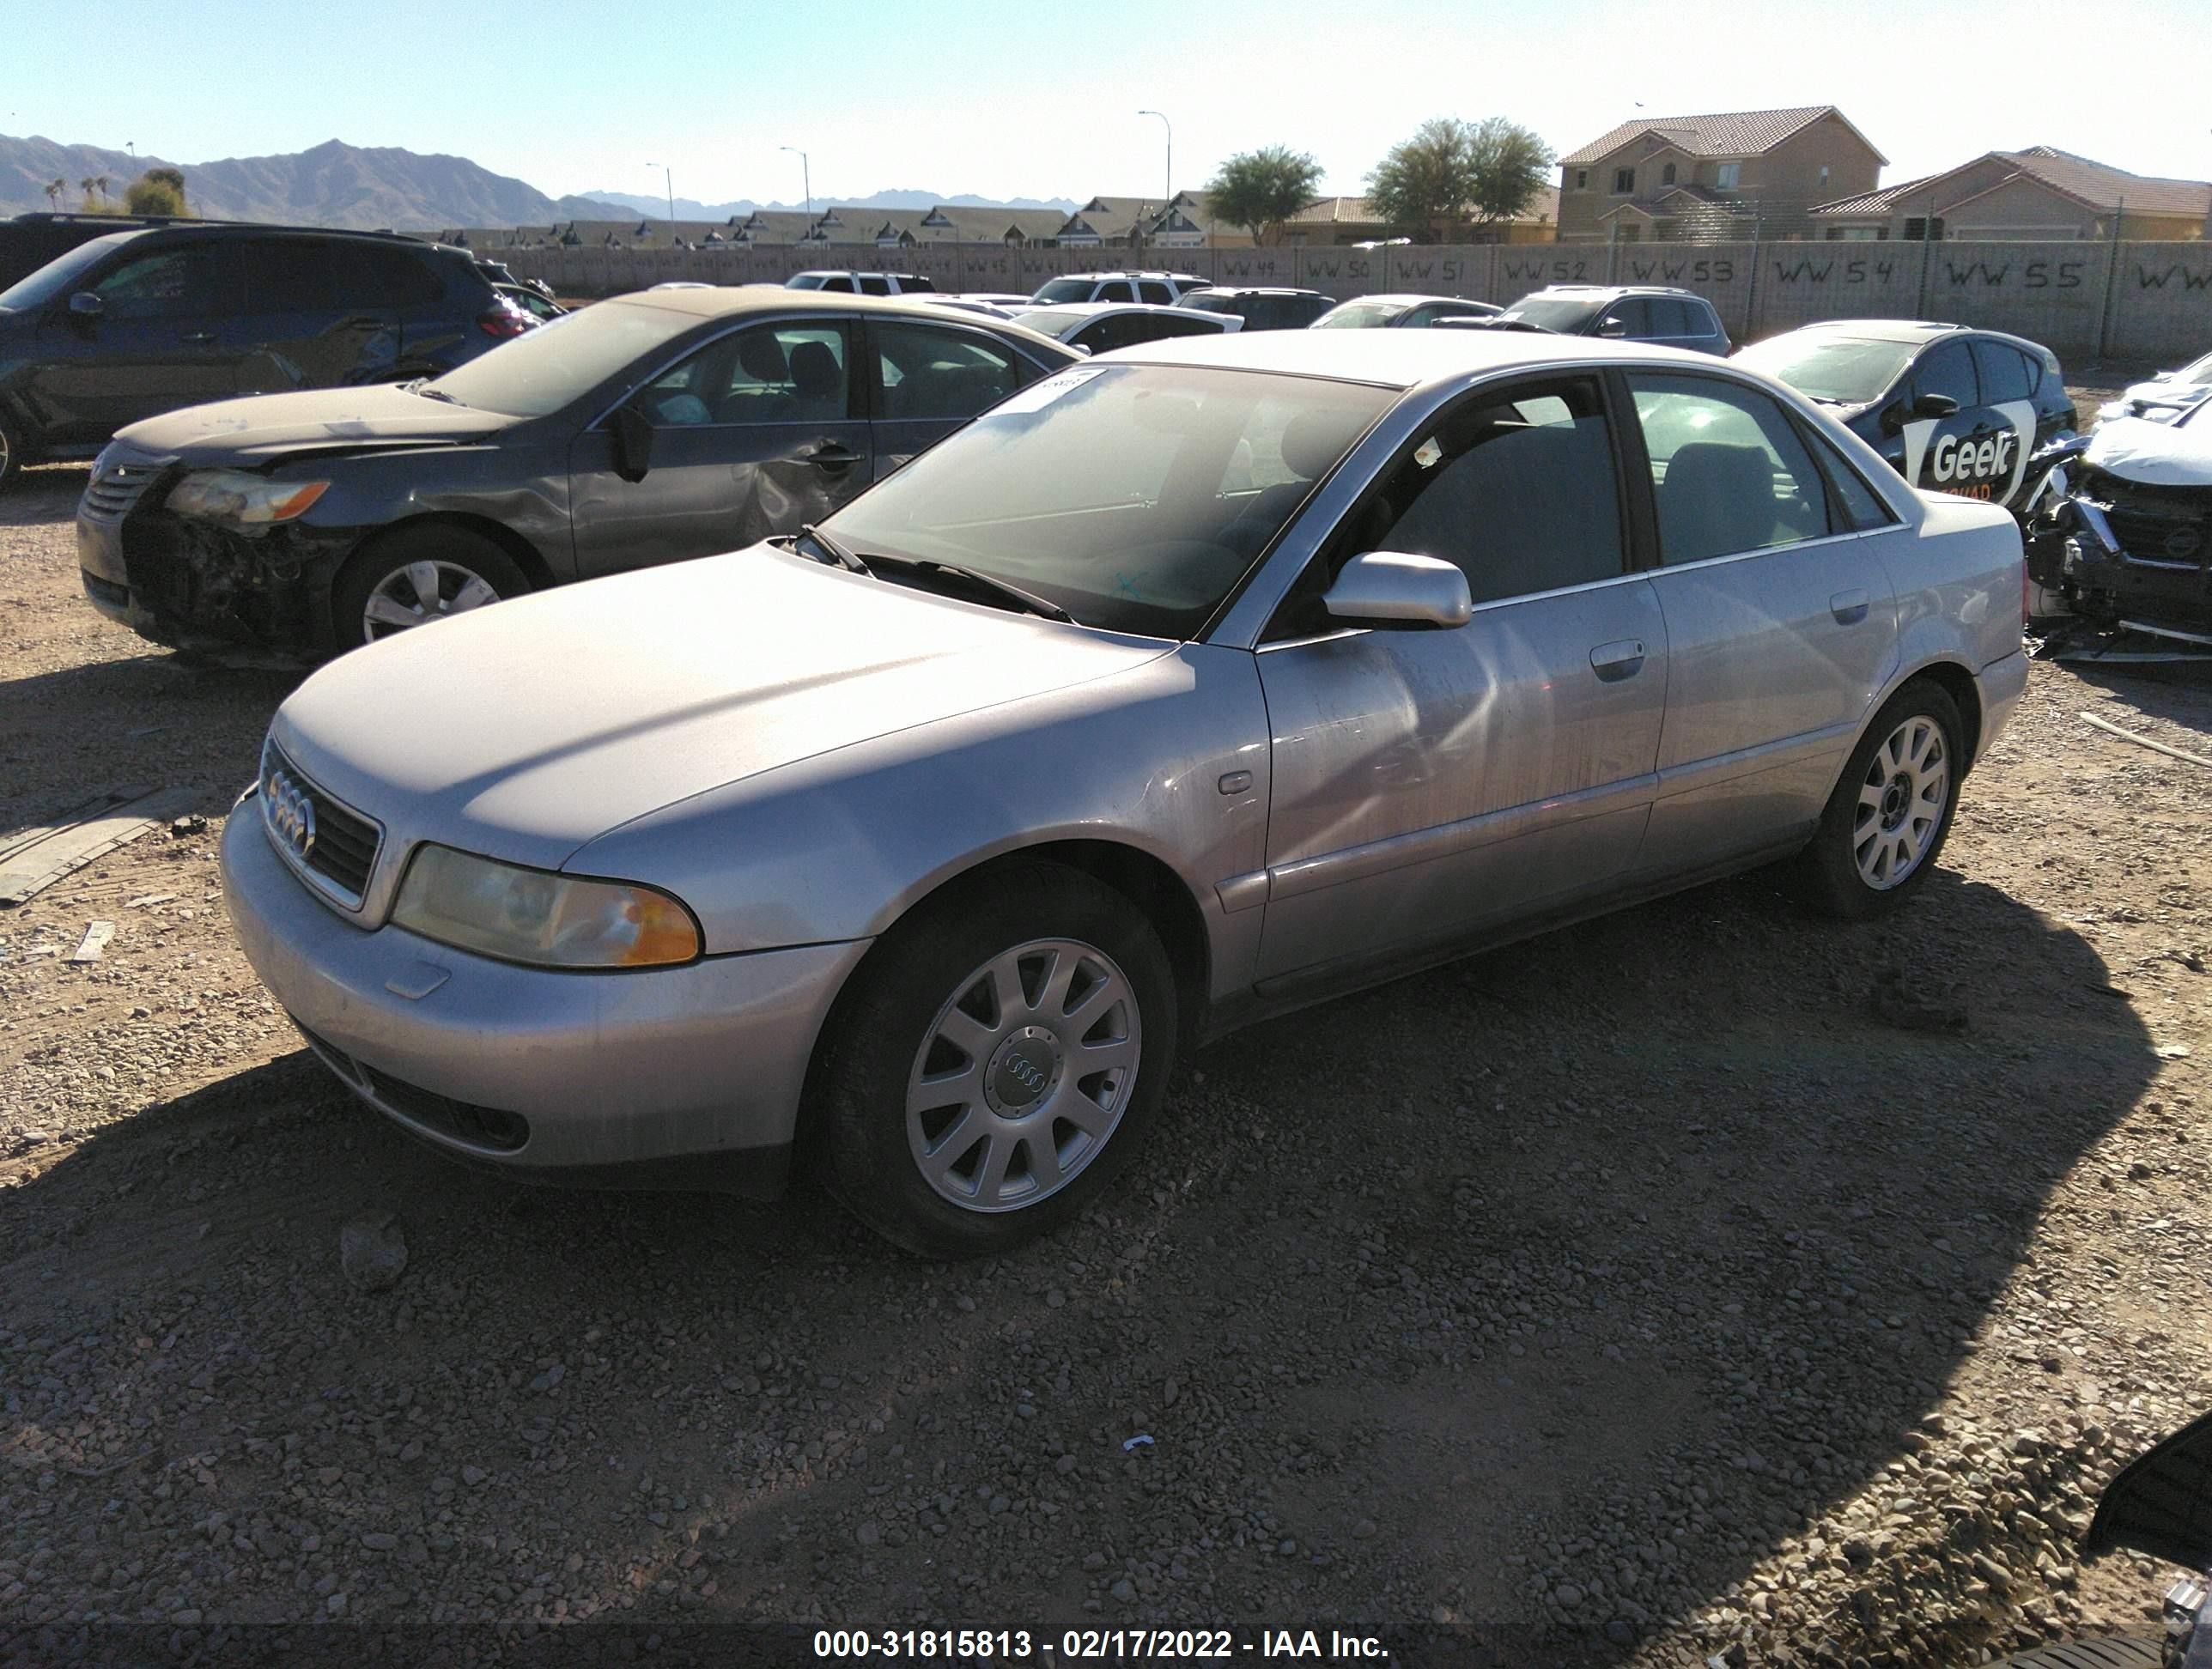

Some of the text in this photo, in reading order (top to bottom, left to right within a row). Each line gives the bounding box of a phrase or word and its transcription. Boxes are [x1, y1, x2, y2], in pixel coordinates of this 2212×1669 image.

[967, 259, 988, 273] WW
[1023, 260, 1043, 273] WW
[1224, 260, 1275, 276] WW 49
[1307, 261, 1370, 278] WW 50
[1397, 261, 1464, 281] WW 51
[1504, 261, 1588, 282] WW 52
[1632, 260, 1734, 282] WW 53
[1776, 261, 1893, 284] WW 54
[1947, 262, 2084, 288] WW 55
[2138, 264, 2212, 289] WW
[1935, 431, 2011, 482] Geek
